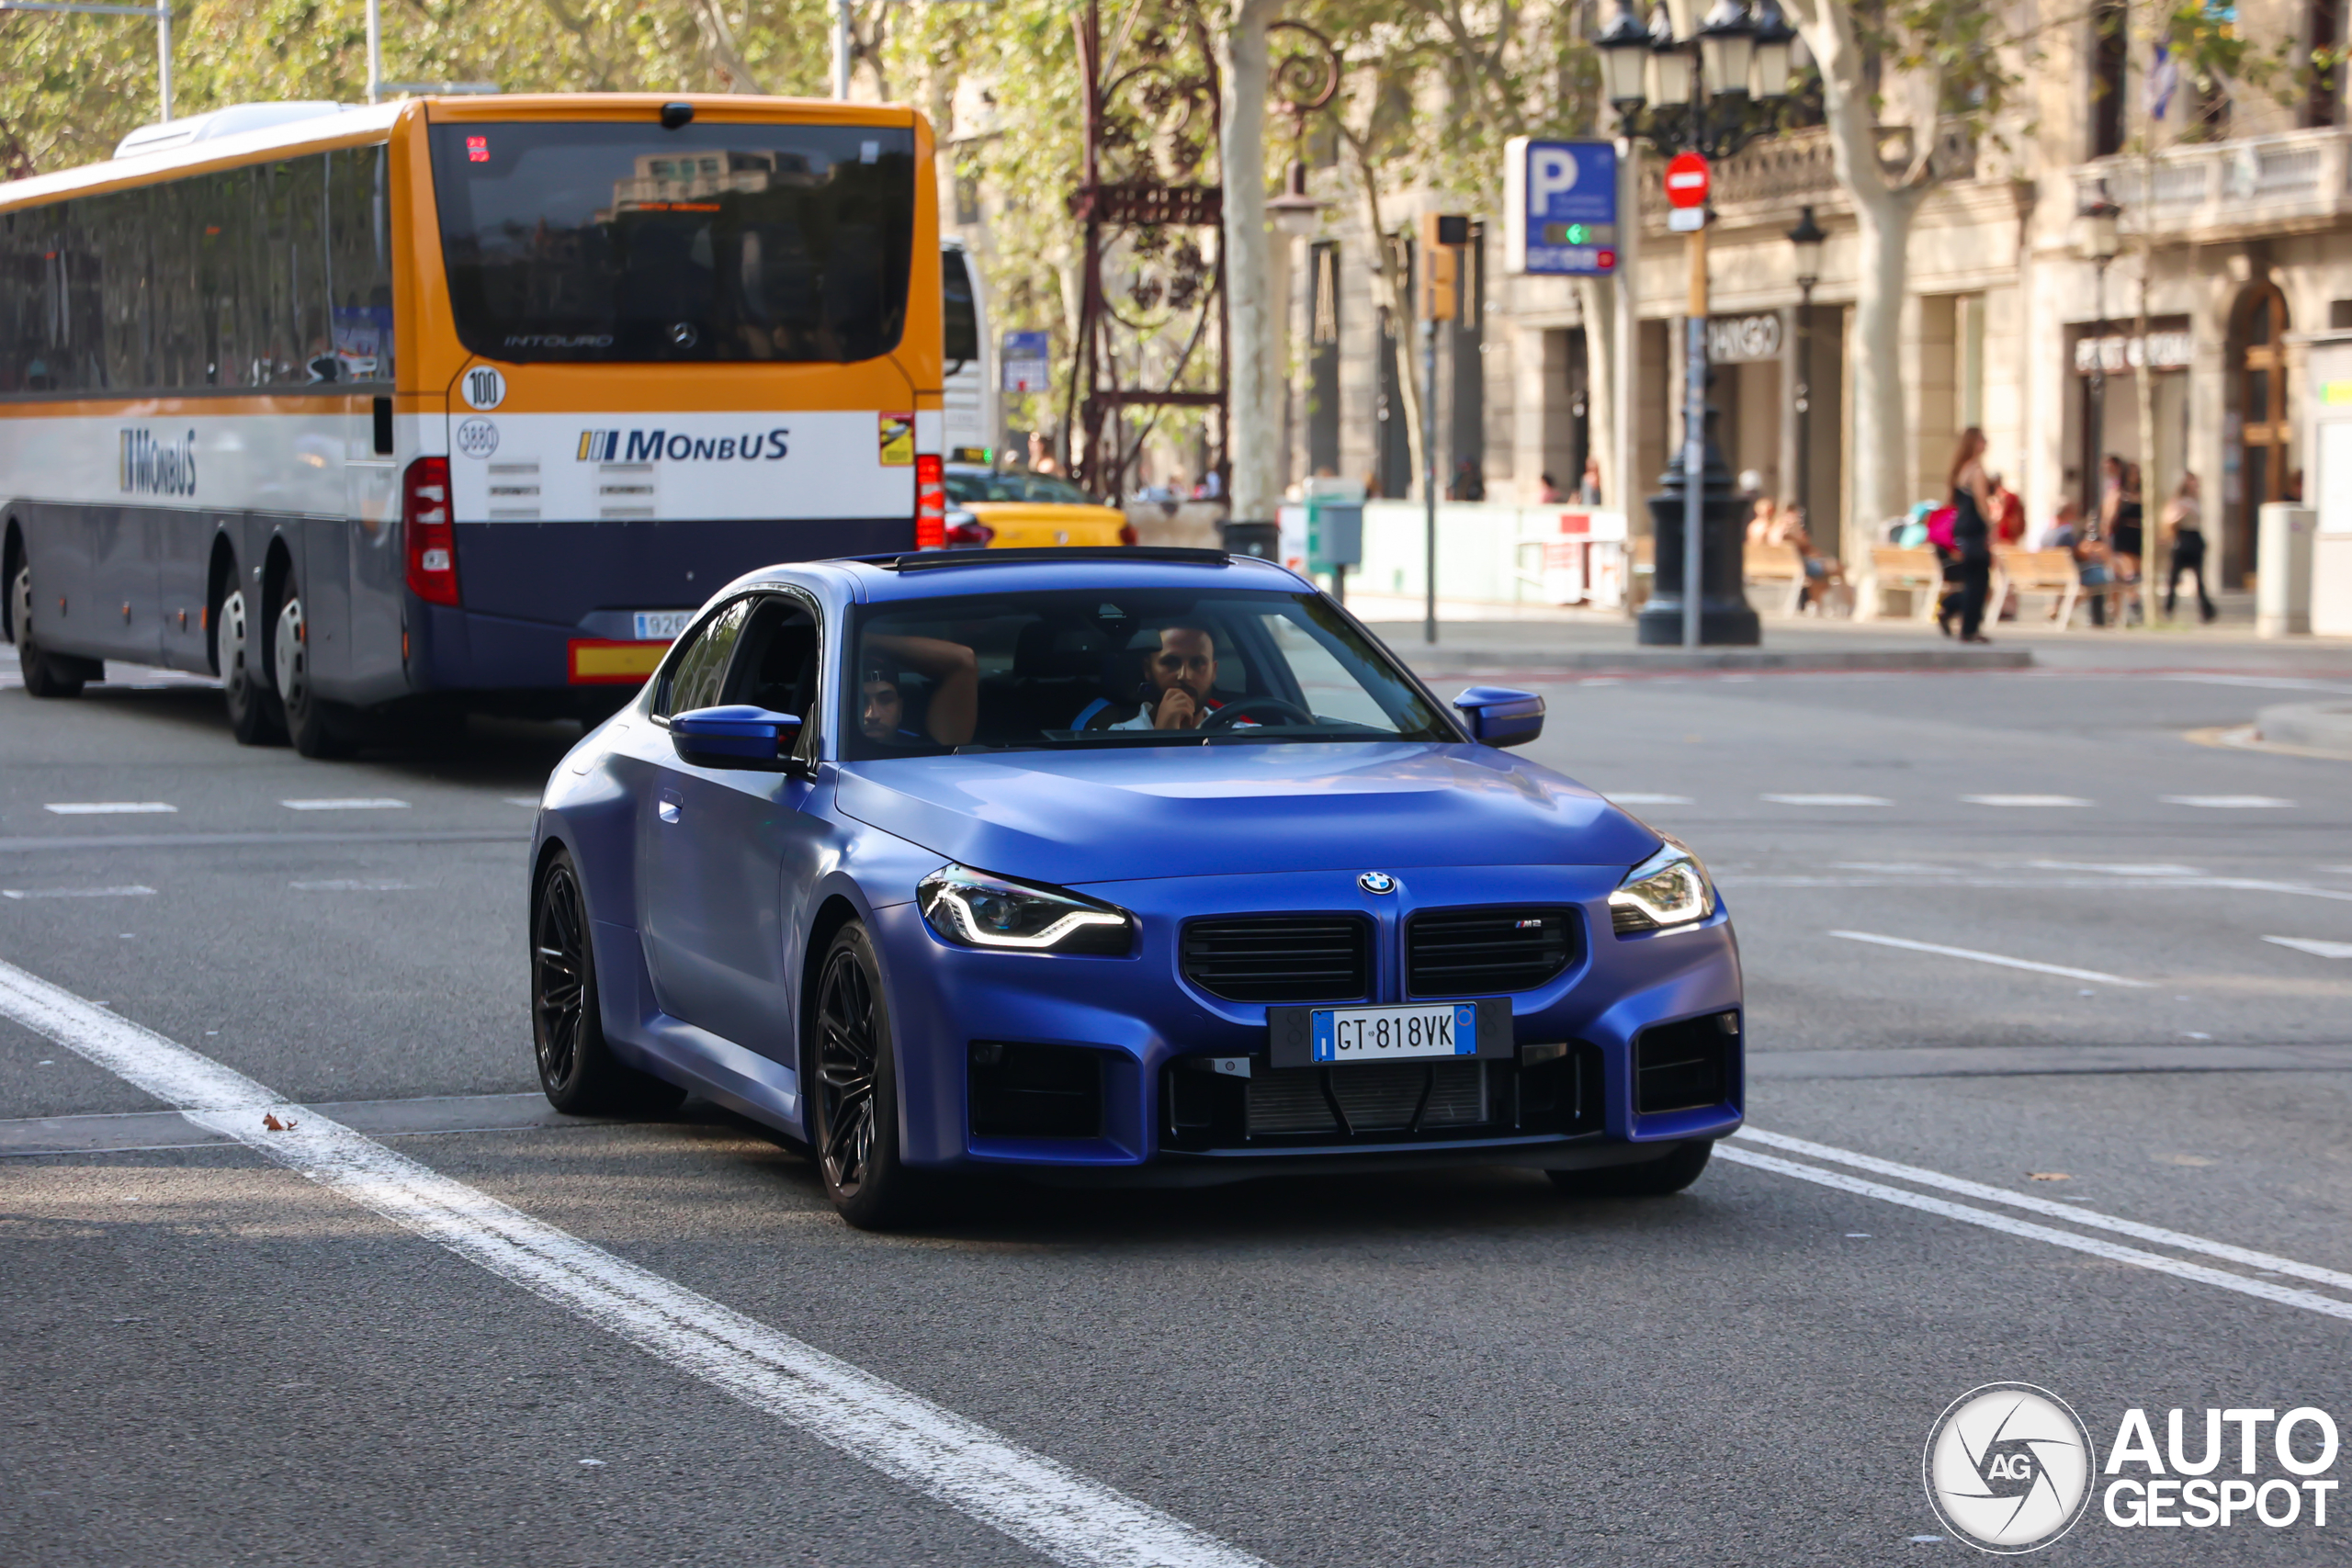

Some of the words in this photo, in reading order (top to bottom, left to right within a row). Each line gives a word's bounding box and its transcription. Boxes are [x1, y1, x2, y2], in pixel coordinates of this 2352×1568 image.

[1530, 148, 1579, 216] P
[503, 334, 615, 347] INTOURO
[469, 371, 497, 404] 100
